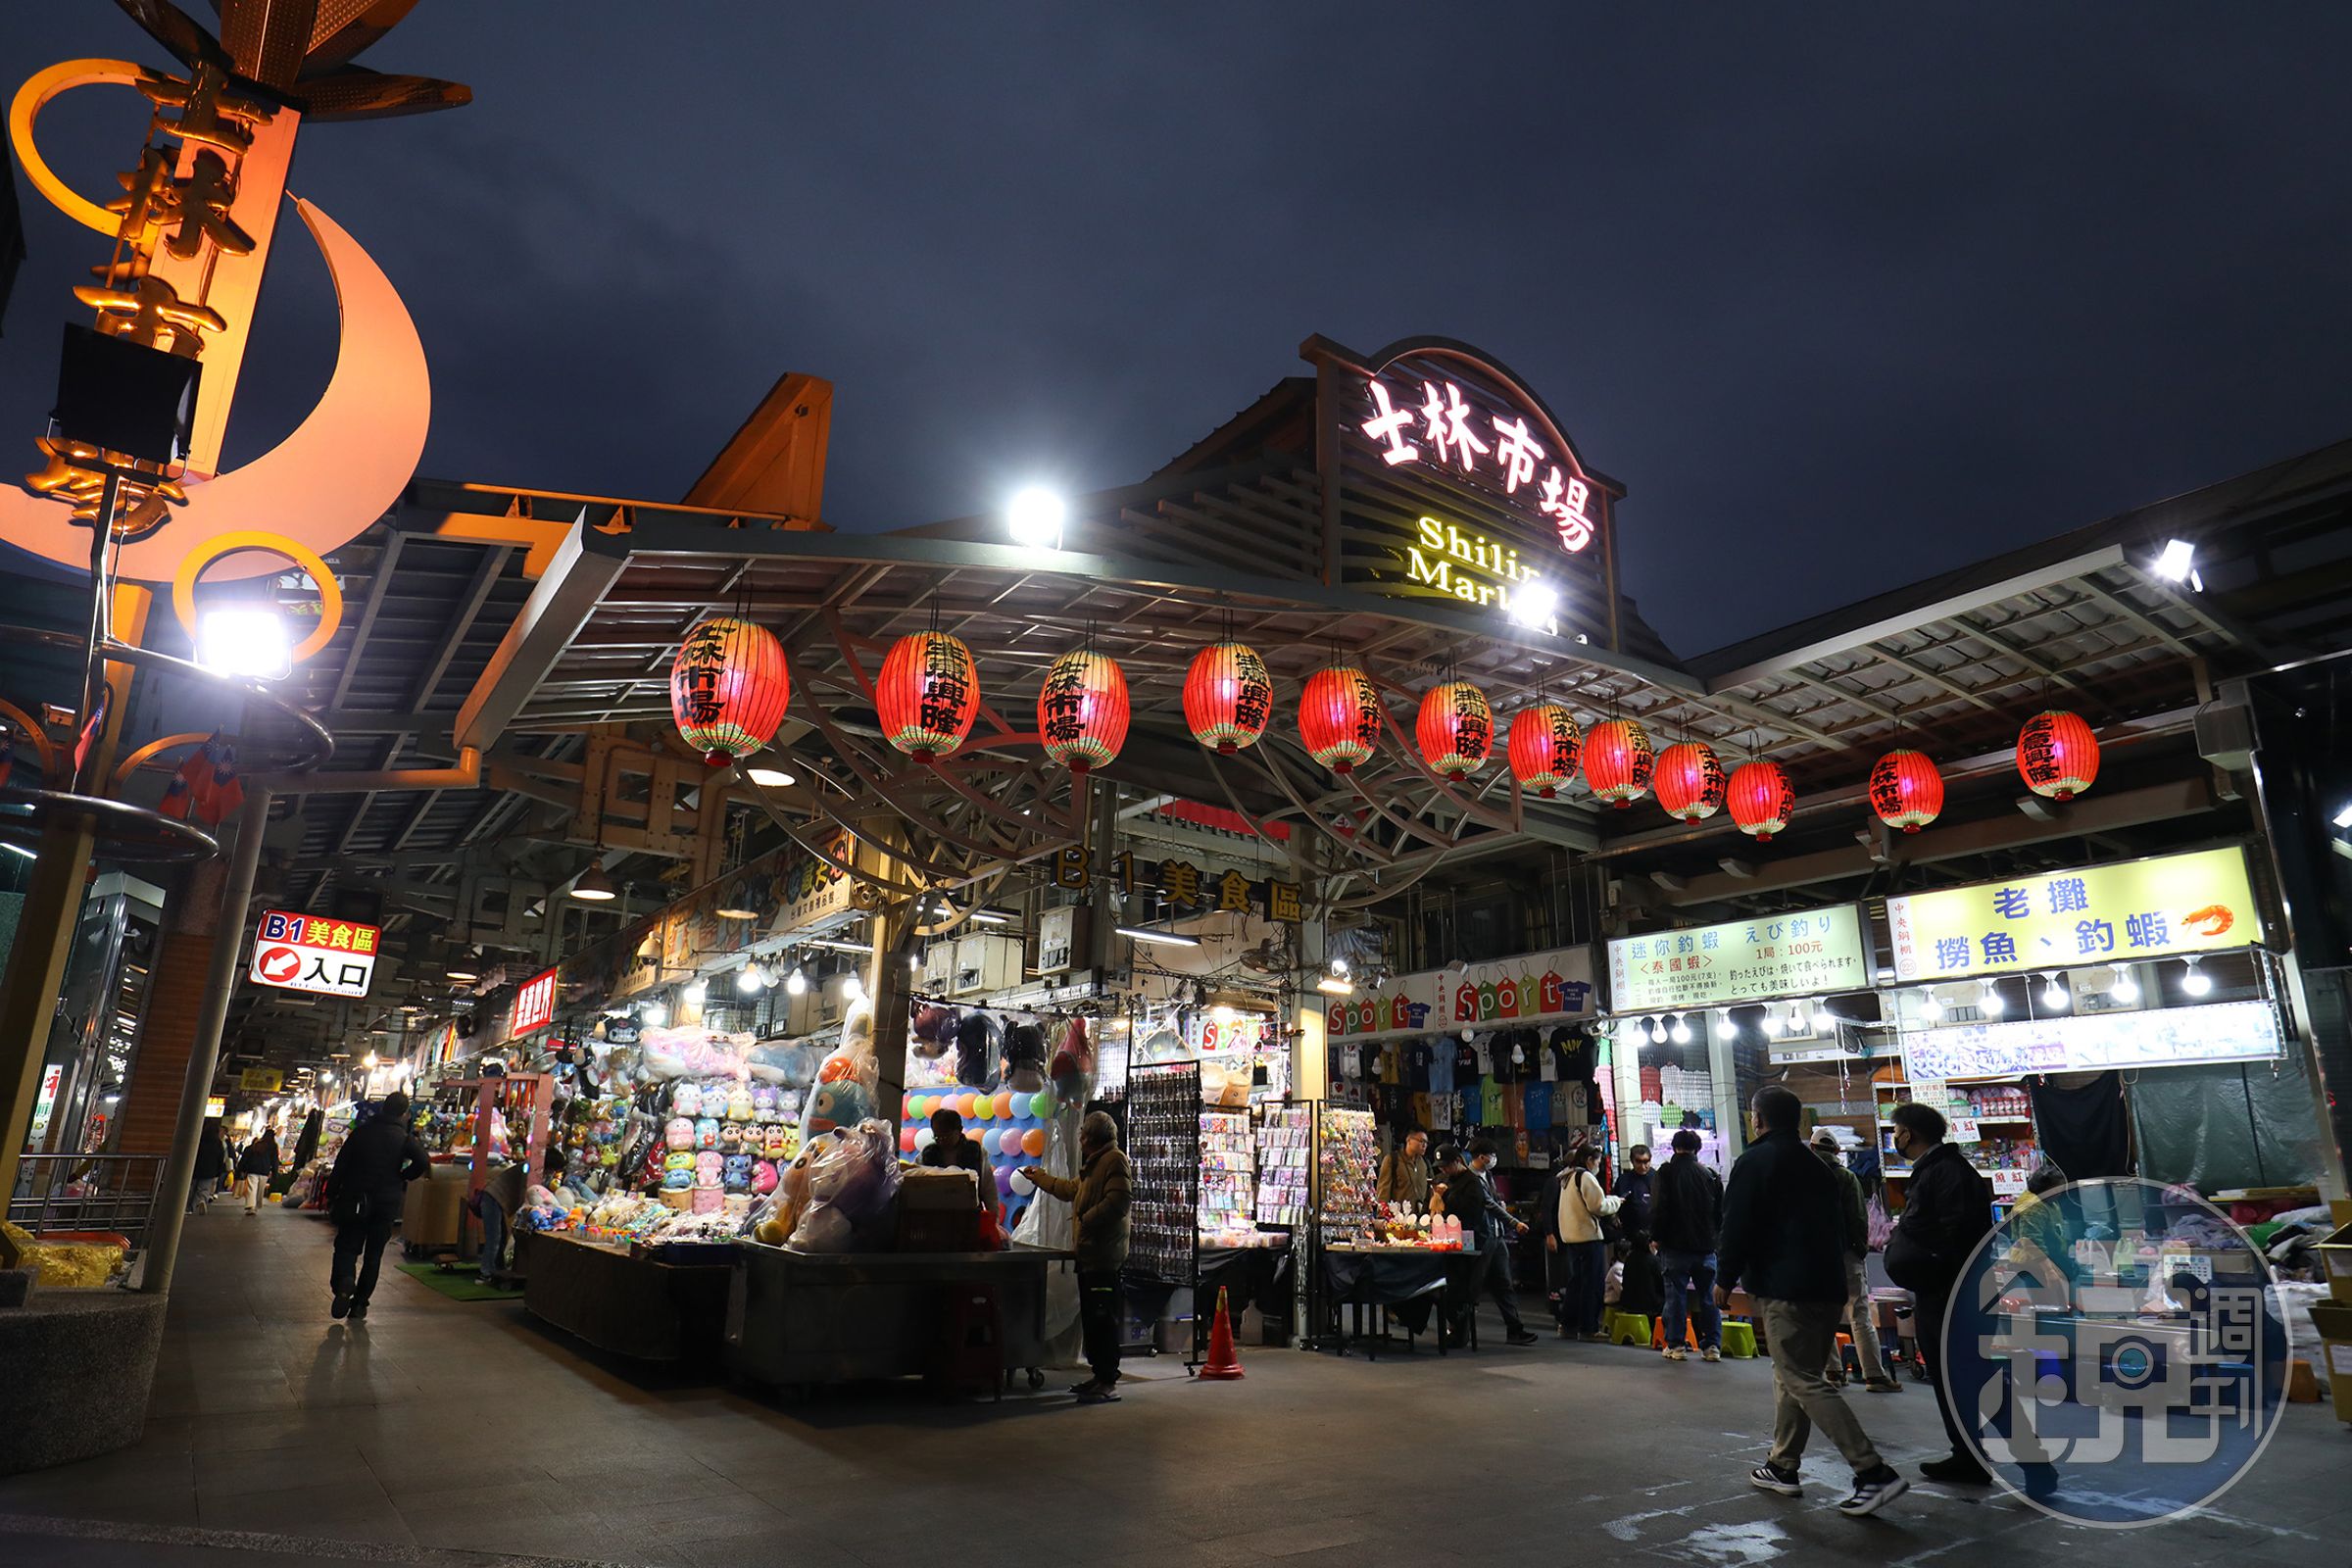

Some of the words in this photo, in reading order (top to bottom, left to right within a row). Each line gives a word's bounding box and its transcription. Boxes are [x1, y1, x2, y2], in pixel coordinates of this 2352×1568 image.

[1360, 378, 1595, 554] 士林市場
[675, 624, 737, 724] 士林市場
[922, 638, 969, 735] 生意興隆
[1044, 661, 1090, 741] 士林市場
[1235, 652, 1270, 730] 生意興隆
[1454, 689, 1489, 760] 生意興隆
[1549, 710, 1580, 777] 士林市場
[2021, 718, 2061, 785] 生意興隆
[1871, 760, 1903, 814] 士林市場
[1745, 915, 1831, 944] えび釣り
[1993, 878, 2089, 919] 老攤
[1632, 931, 1719, 959] 迷你釣蝦
[1936, 910, 2171, 970] 撈魚、釣蝦
[304, 956, 368, 988] 入口
[1458, 981, 1556, 1020] Sport
[1330, 1003, 1404, 1034] Sport
